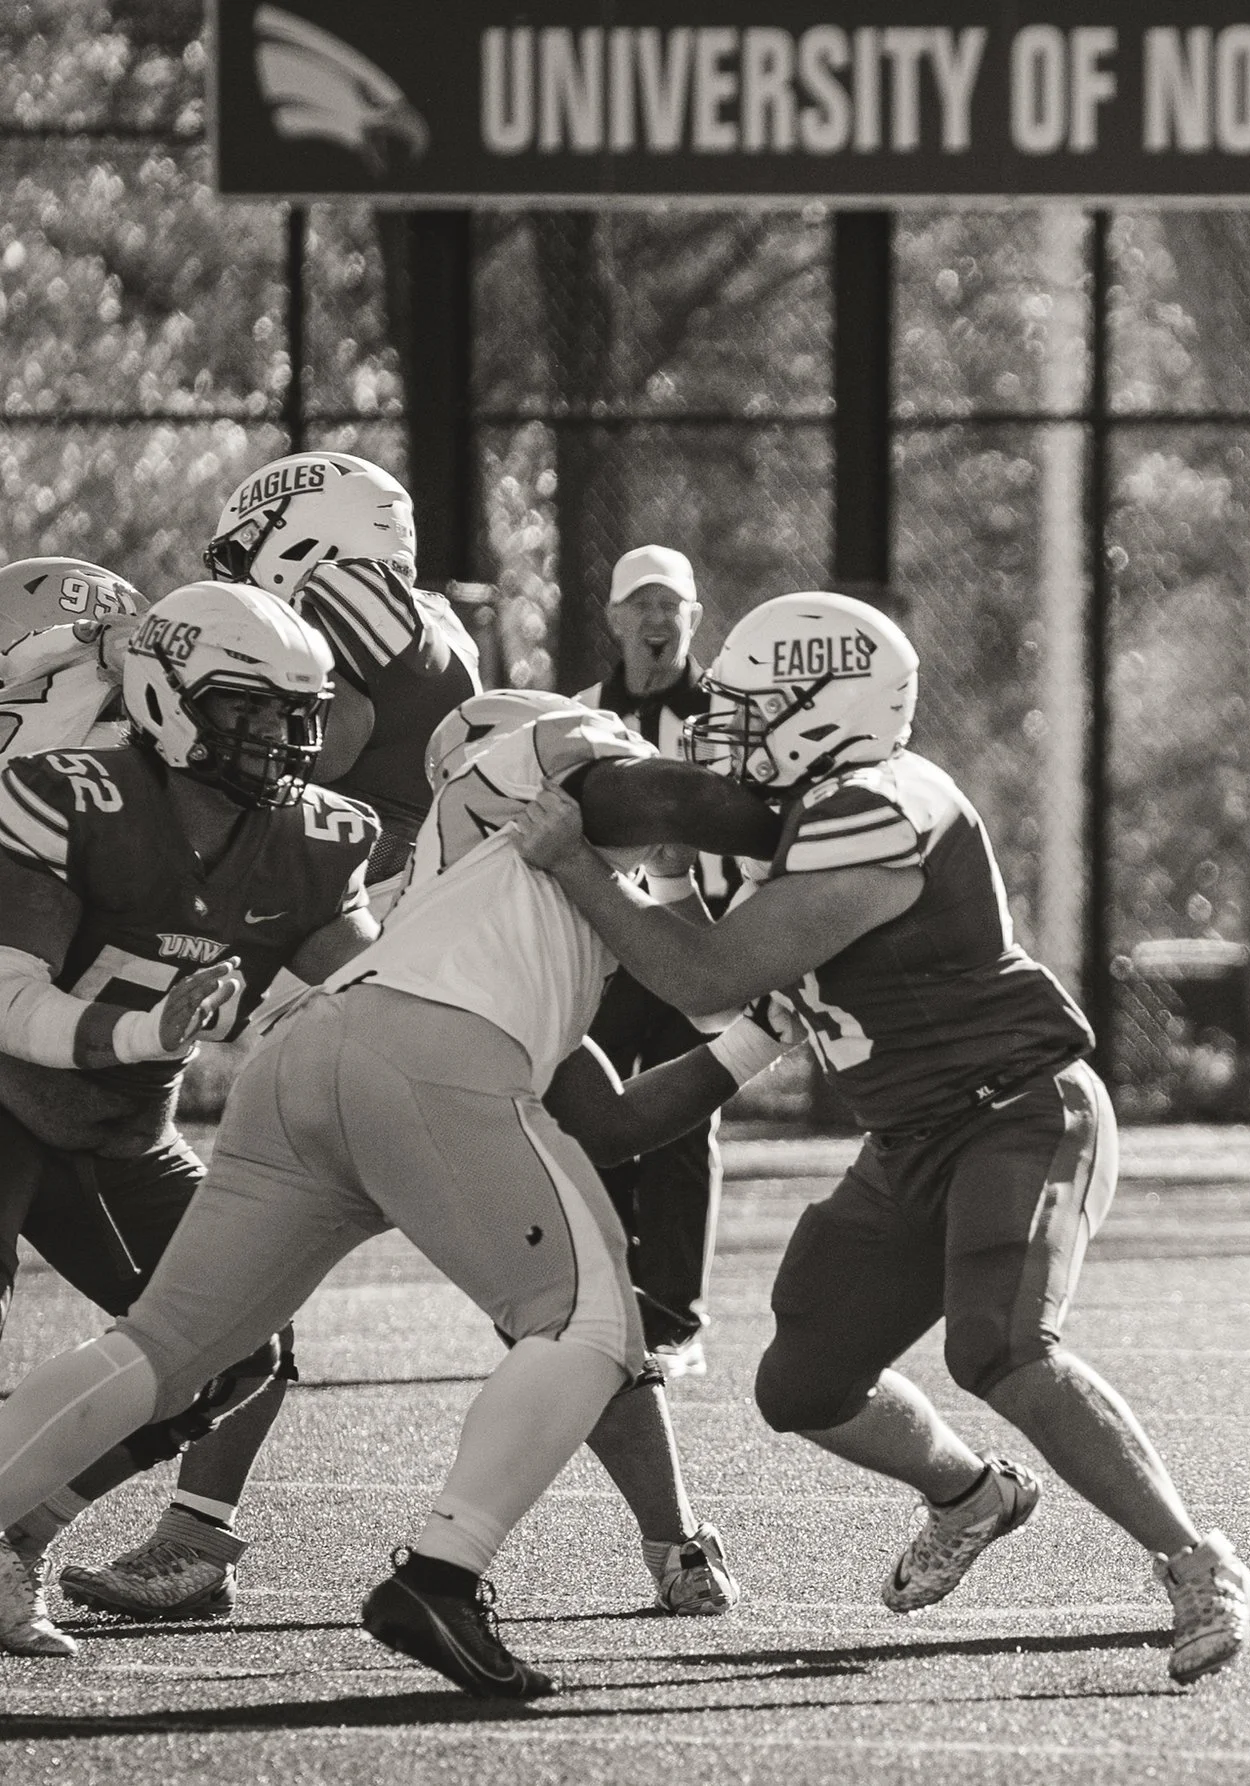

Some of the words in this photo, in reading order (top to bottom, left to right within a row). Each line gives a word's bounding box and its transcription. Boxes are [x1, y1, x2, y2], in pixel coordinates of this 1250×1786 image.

[481, 25, 986, 154] UNIVERSITY
[1010, 24, 1117, 153] OF
[239, 464, 326, 514] EAGLES
[129, 614, 202, 660] AGLES
[773, 635, 872, 677] EAGLES
[46, 753, 124, 813] 52
[156, 933, 231, 964] UNW
